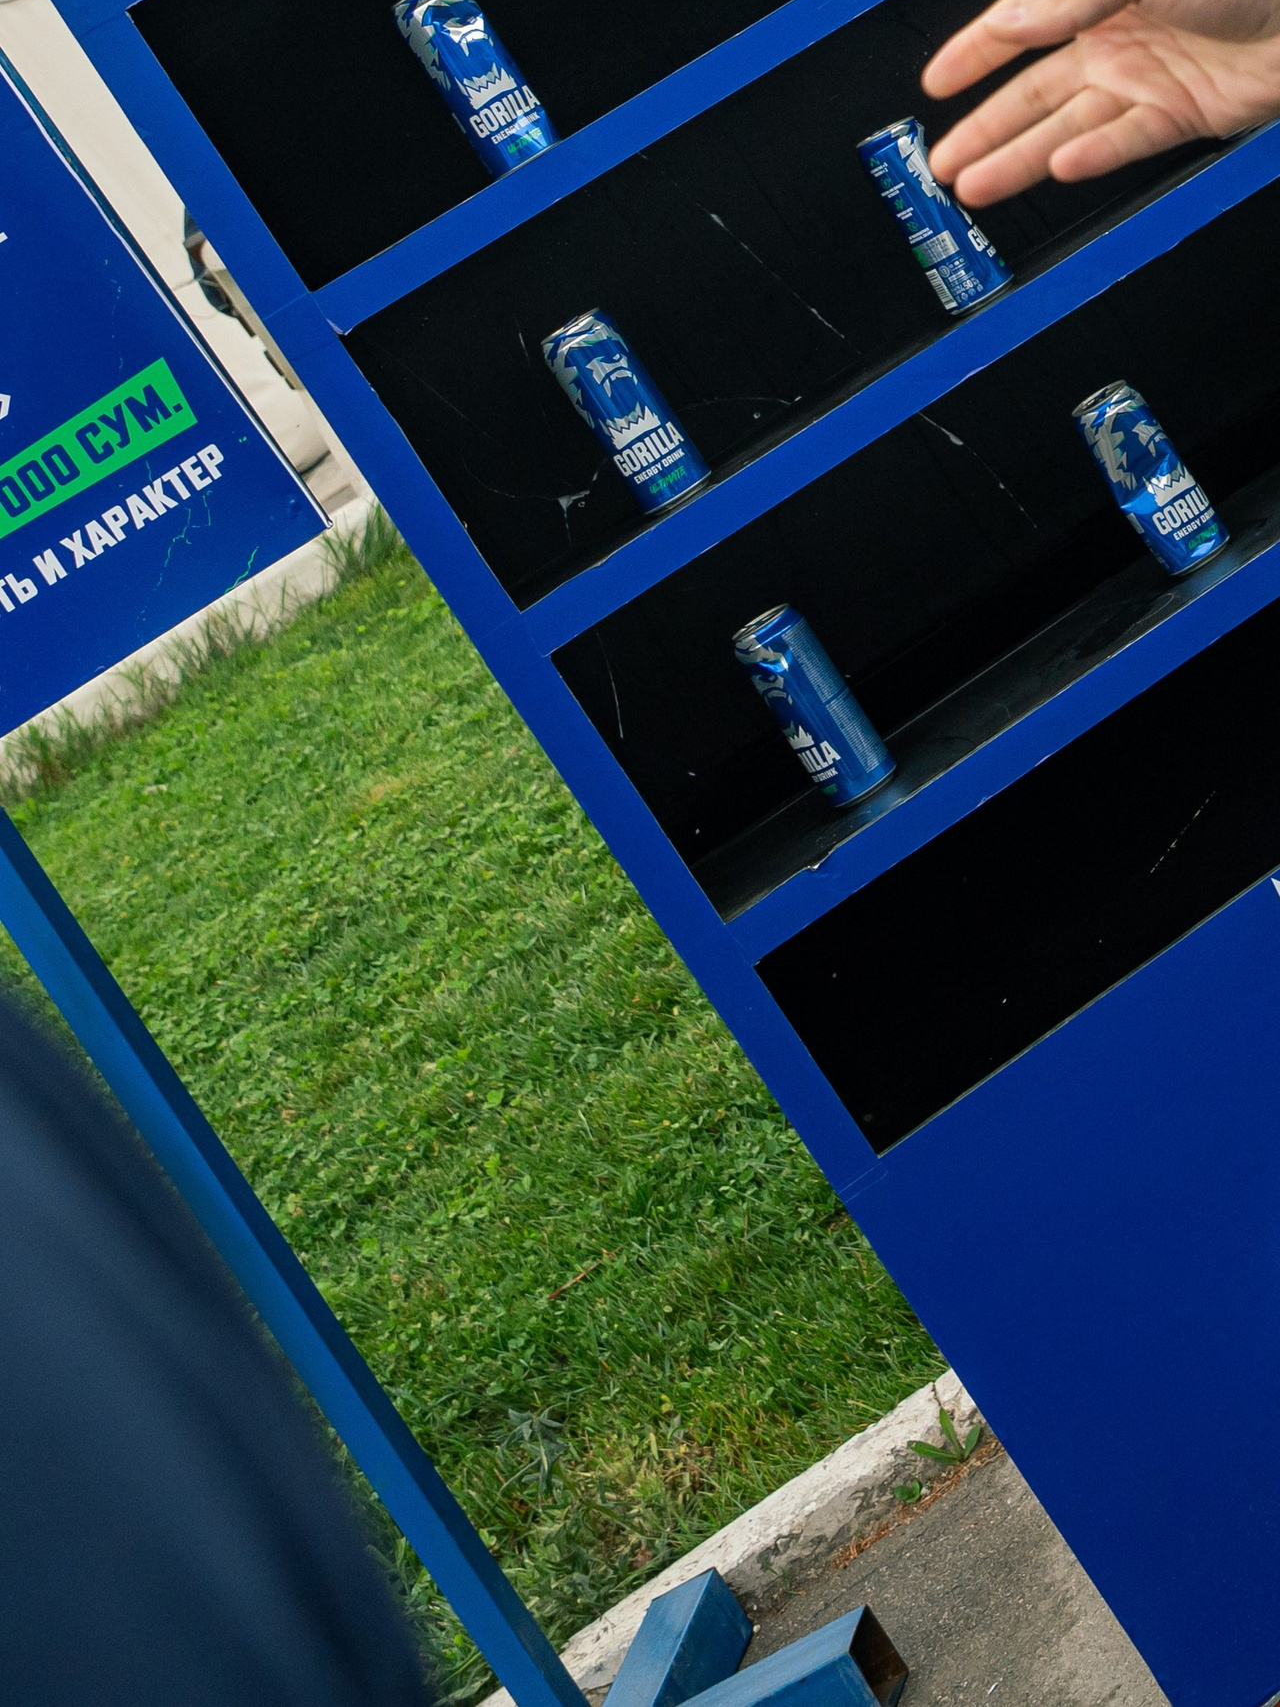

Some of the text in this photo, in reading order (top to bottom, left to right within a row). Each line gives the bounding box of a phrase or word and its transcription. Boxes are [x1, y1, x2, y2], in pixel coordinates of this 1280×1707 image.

[469, 85, 541, 138] GORILLA
[491, 120, 520, 144] ENERGY
[75, 383, 184, 465] СУМ.
[613, 421, 684, 477] GORILLA
[634, 448, 685, 484] ENERGY DRINK
[649, 466, 686, 494] ULTIMATE
[32, 548, 68, 586] И
[59, 444, 225, 569] ХАРАКТЕР
[1152, 484, 1210, 535] GORILL
[1173, 519, 1201, 541] ENERGY
